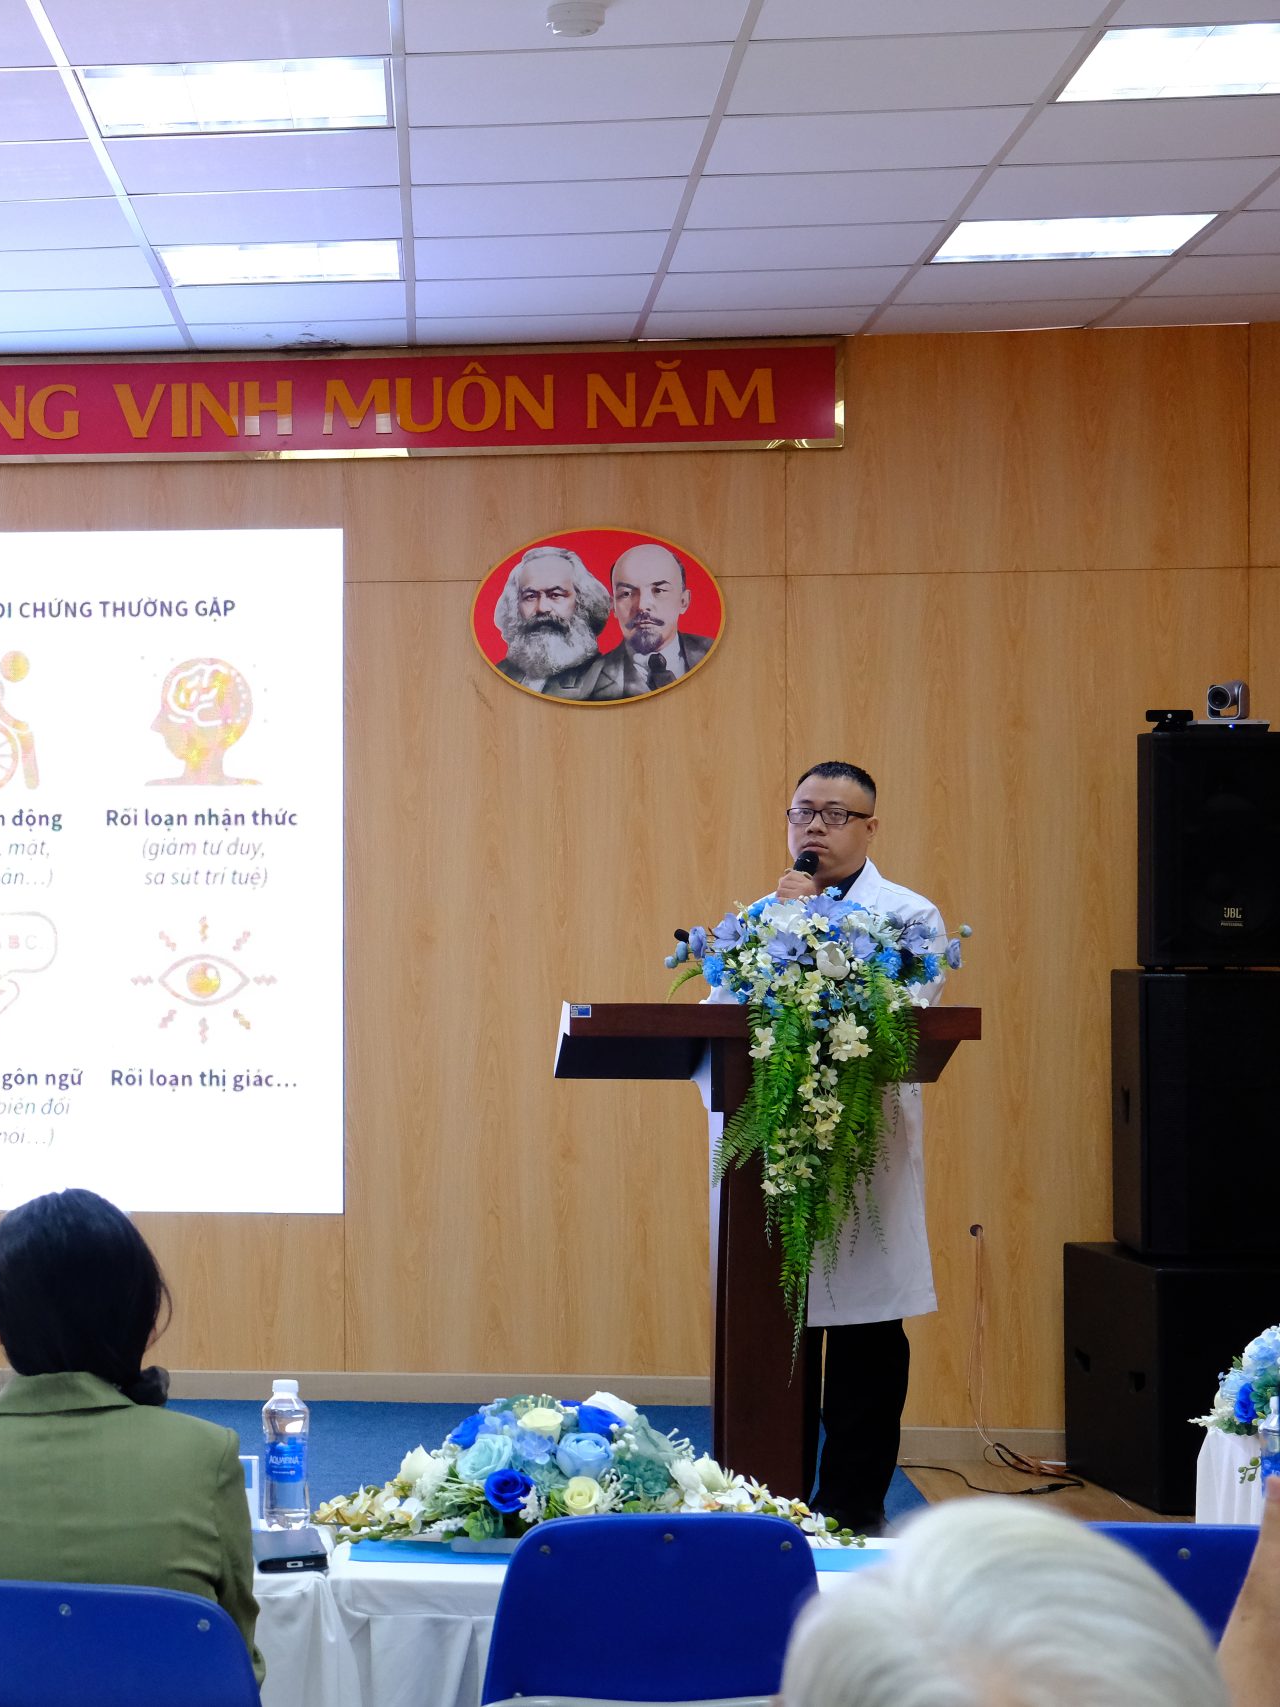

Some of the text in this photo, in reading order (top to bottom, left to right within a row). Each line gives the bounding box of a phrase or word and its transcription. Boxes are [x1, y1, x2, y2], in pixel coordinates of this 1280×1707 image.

[113, 380, 293, 438] VINH
[323, 362, 554, 435] MUÔN
[587, 360, 776, 427] NĂM
[19, 598, 92, 618] CHỨNG
[99, 597, 188, 618] THƯỜNG
[11, 809, 63, 832] động
[144, 808, 188, 832] loạn
[194, 808, 246, 832] nhận
[251, 808, 298, 826] thức
[144, 871, 165, 886] sa
[1224, 907, 1242, 919] JBL
[45, 1068, 84, 1091] ngữ
[149, 1068, 193, 1092] loạn
[199, 1068, 227, 1092] thị
